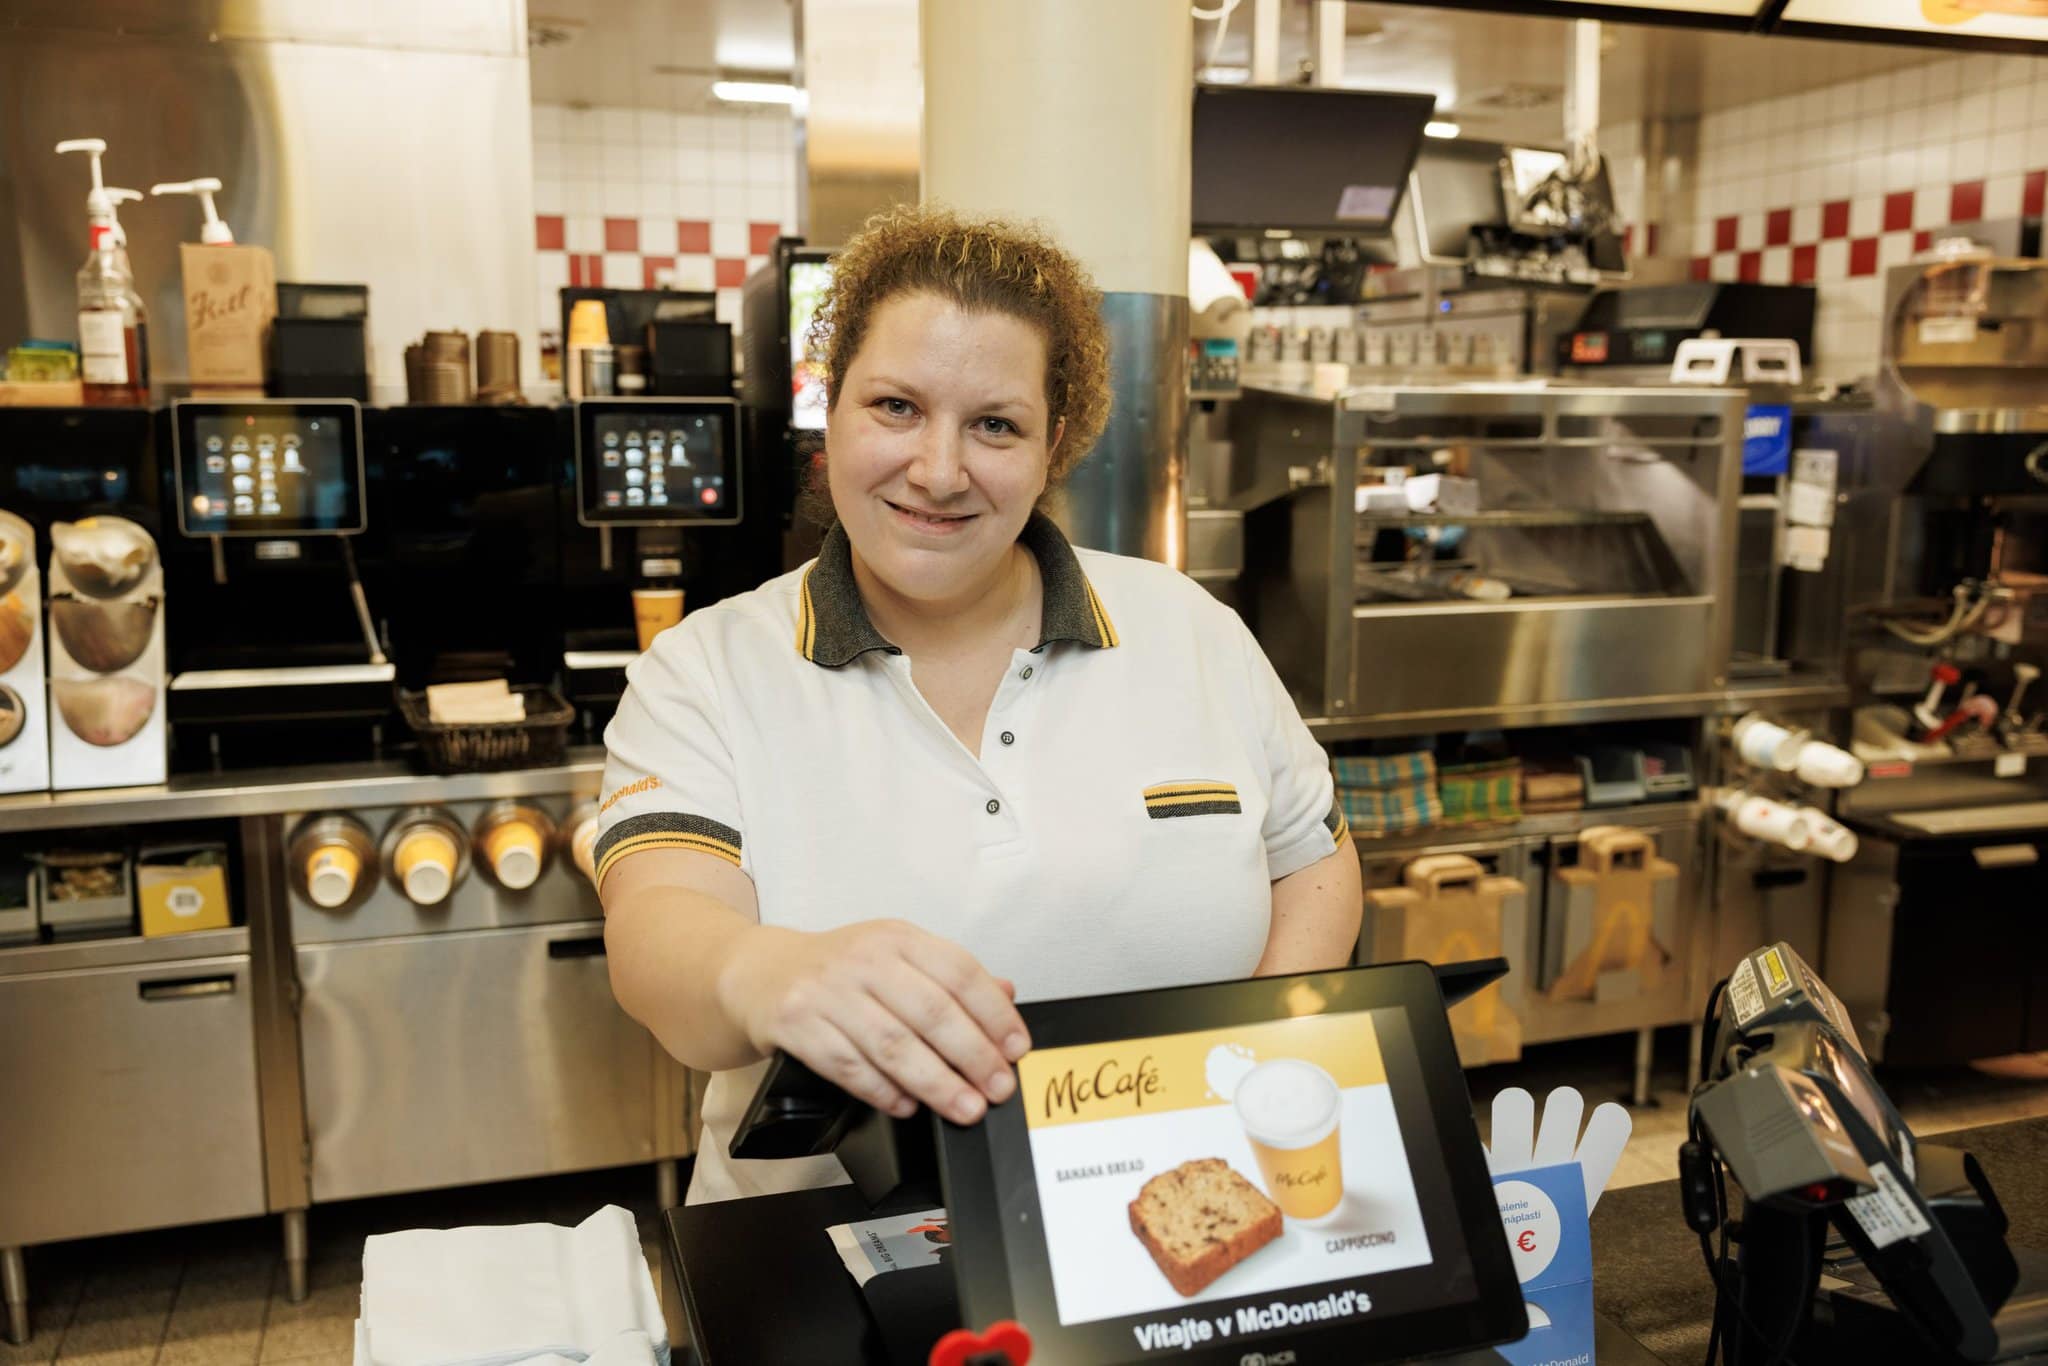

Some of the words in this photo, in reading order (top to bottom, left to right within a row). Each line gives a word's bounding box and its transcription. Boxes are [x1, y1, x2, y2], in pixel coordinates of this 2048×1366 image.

[1045, 1055, 1160, 1119] McCafé
[1056, 1164, 1104, 1183] BANANA
[1106, 1157, 1145, 1177] BREAD
[1325, 1229, 1397, 1255] CAPPUCCINO
[1133, 1318, 1214, 1352] Vitajte
[1216, 1315, 1232, 1338] v
[1235, 1289, 1373, 1335] McDonald's
